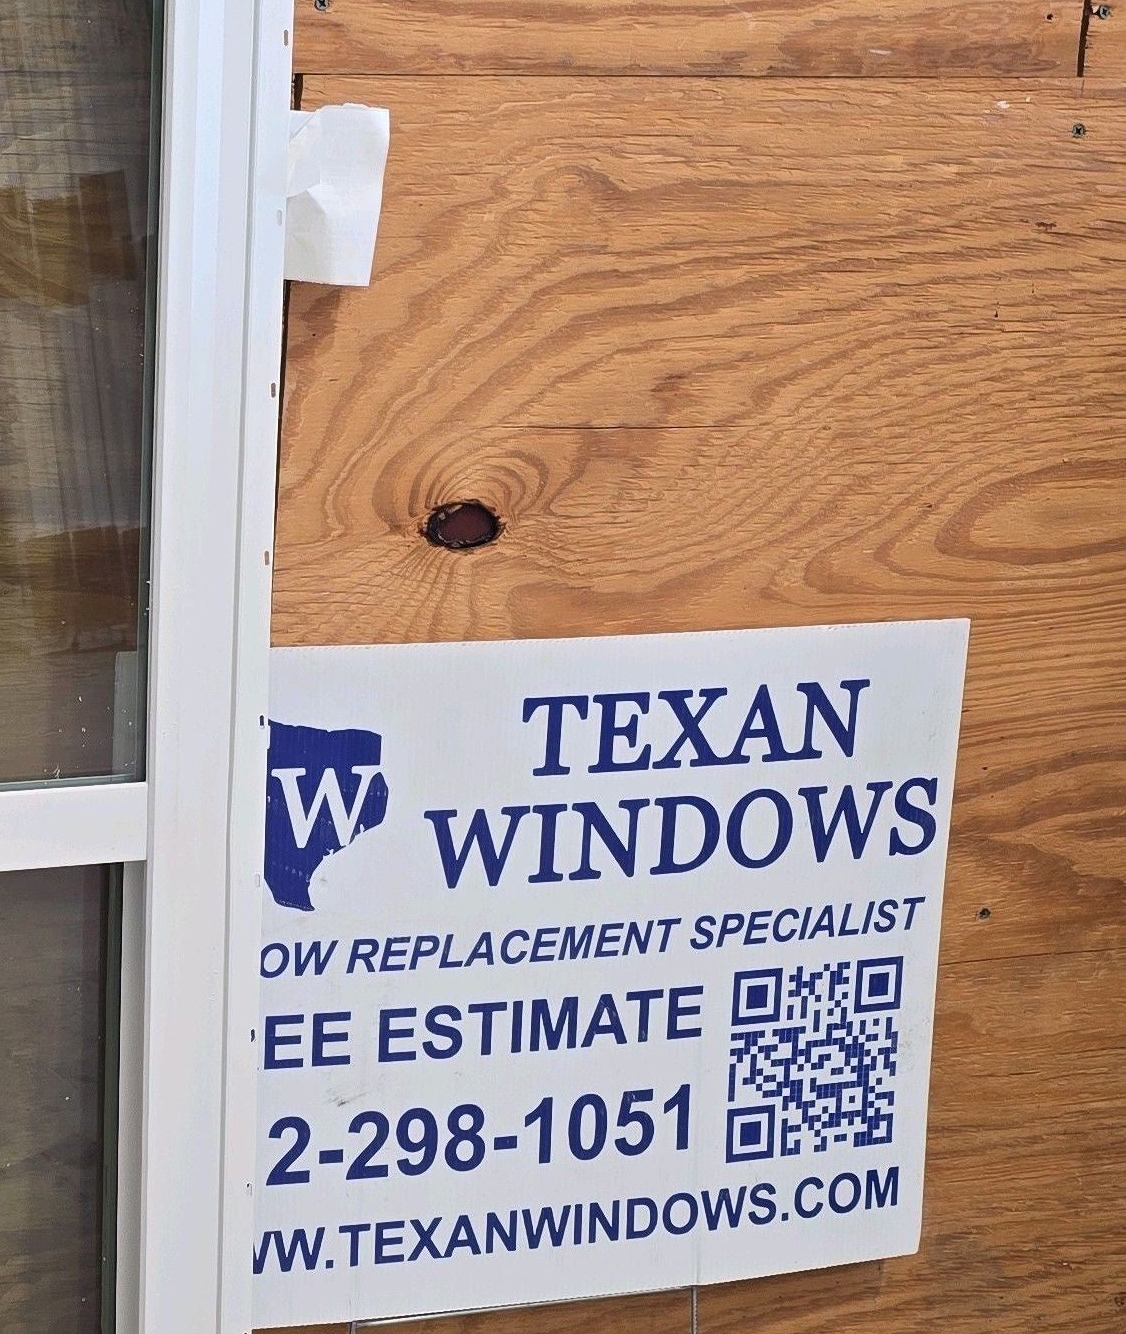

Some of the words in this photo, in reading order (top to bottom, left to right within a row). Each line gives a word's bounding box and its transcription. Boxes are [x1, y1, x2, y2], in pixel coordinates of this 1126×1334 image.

[523, 679, 869, 776] TEXAN
[424, 778, 937, 888] WINDOWS
[347, 919, 681, 972] REPLACEMENT
[692, 897, 923, 949] SPECIALIST
[265, 1012, 351, 1069] EE
[378, 986, 703, 1062] ESTIMATE
[267, 1085, 690, 1185] 2-298-1051
